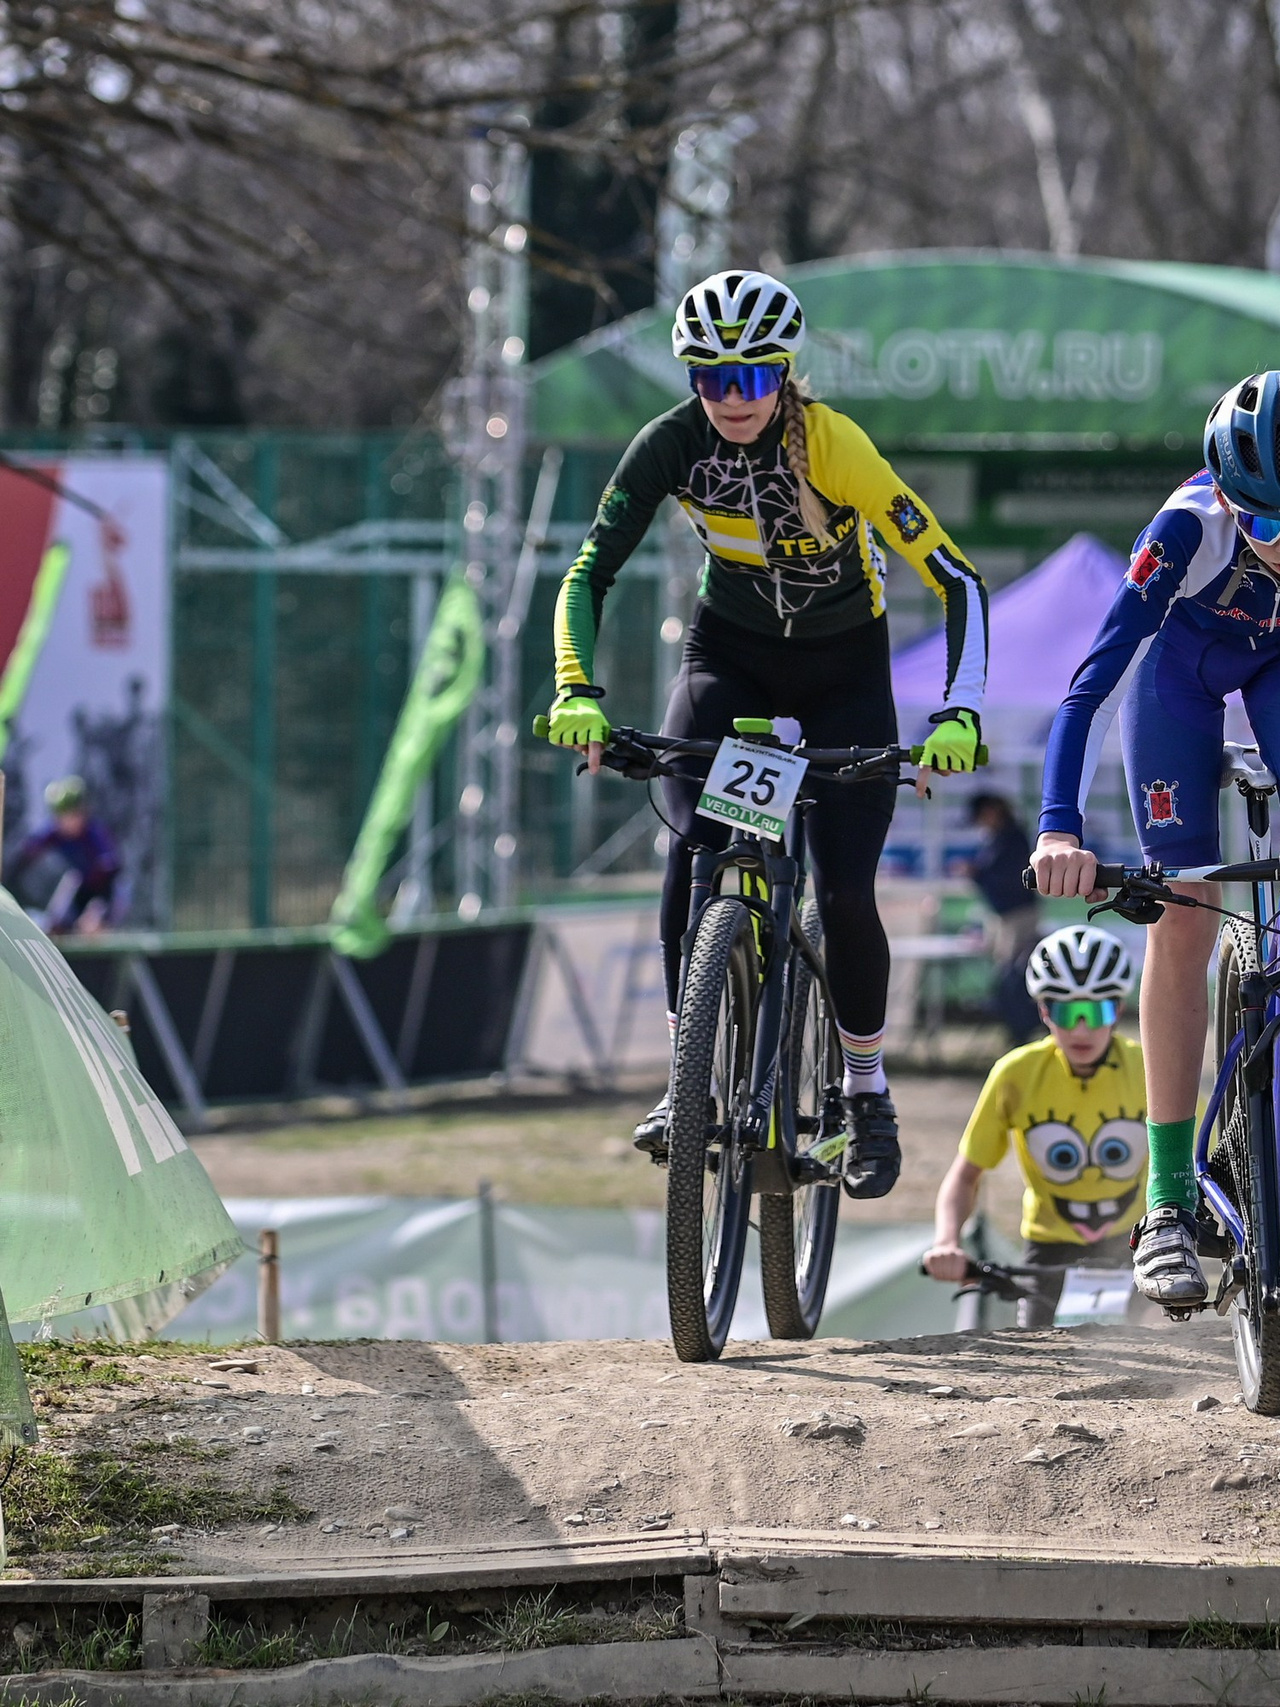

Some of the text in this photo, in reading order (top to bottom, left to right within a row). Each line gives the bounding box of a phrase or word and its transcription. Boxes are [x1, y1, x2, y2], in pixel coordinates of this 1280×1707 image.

[803, 329, 1166, 400] ELOTV.RU
[1221, 431, 1241, 479] RUDY
[776, 516, 854, 557] TEAM
[722, 760, 781, 806] 25
[705, 797, 780, 832] VELOTV.RU
